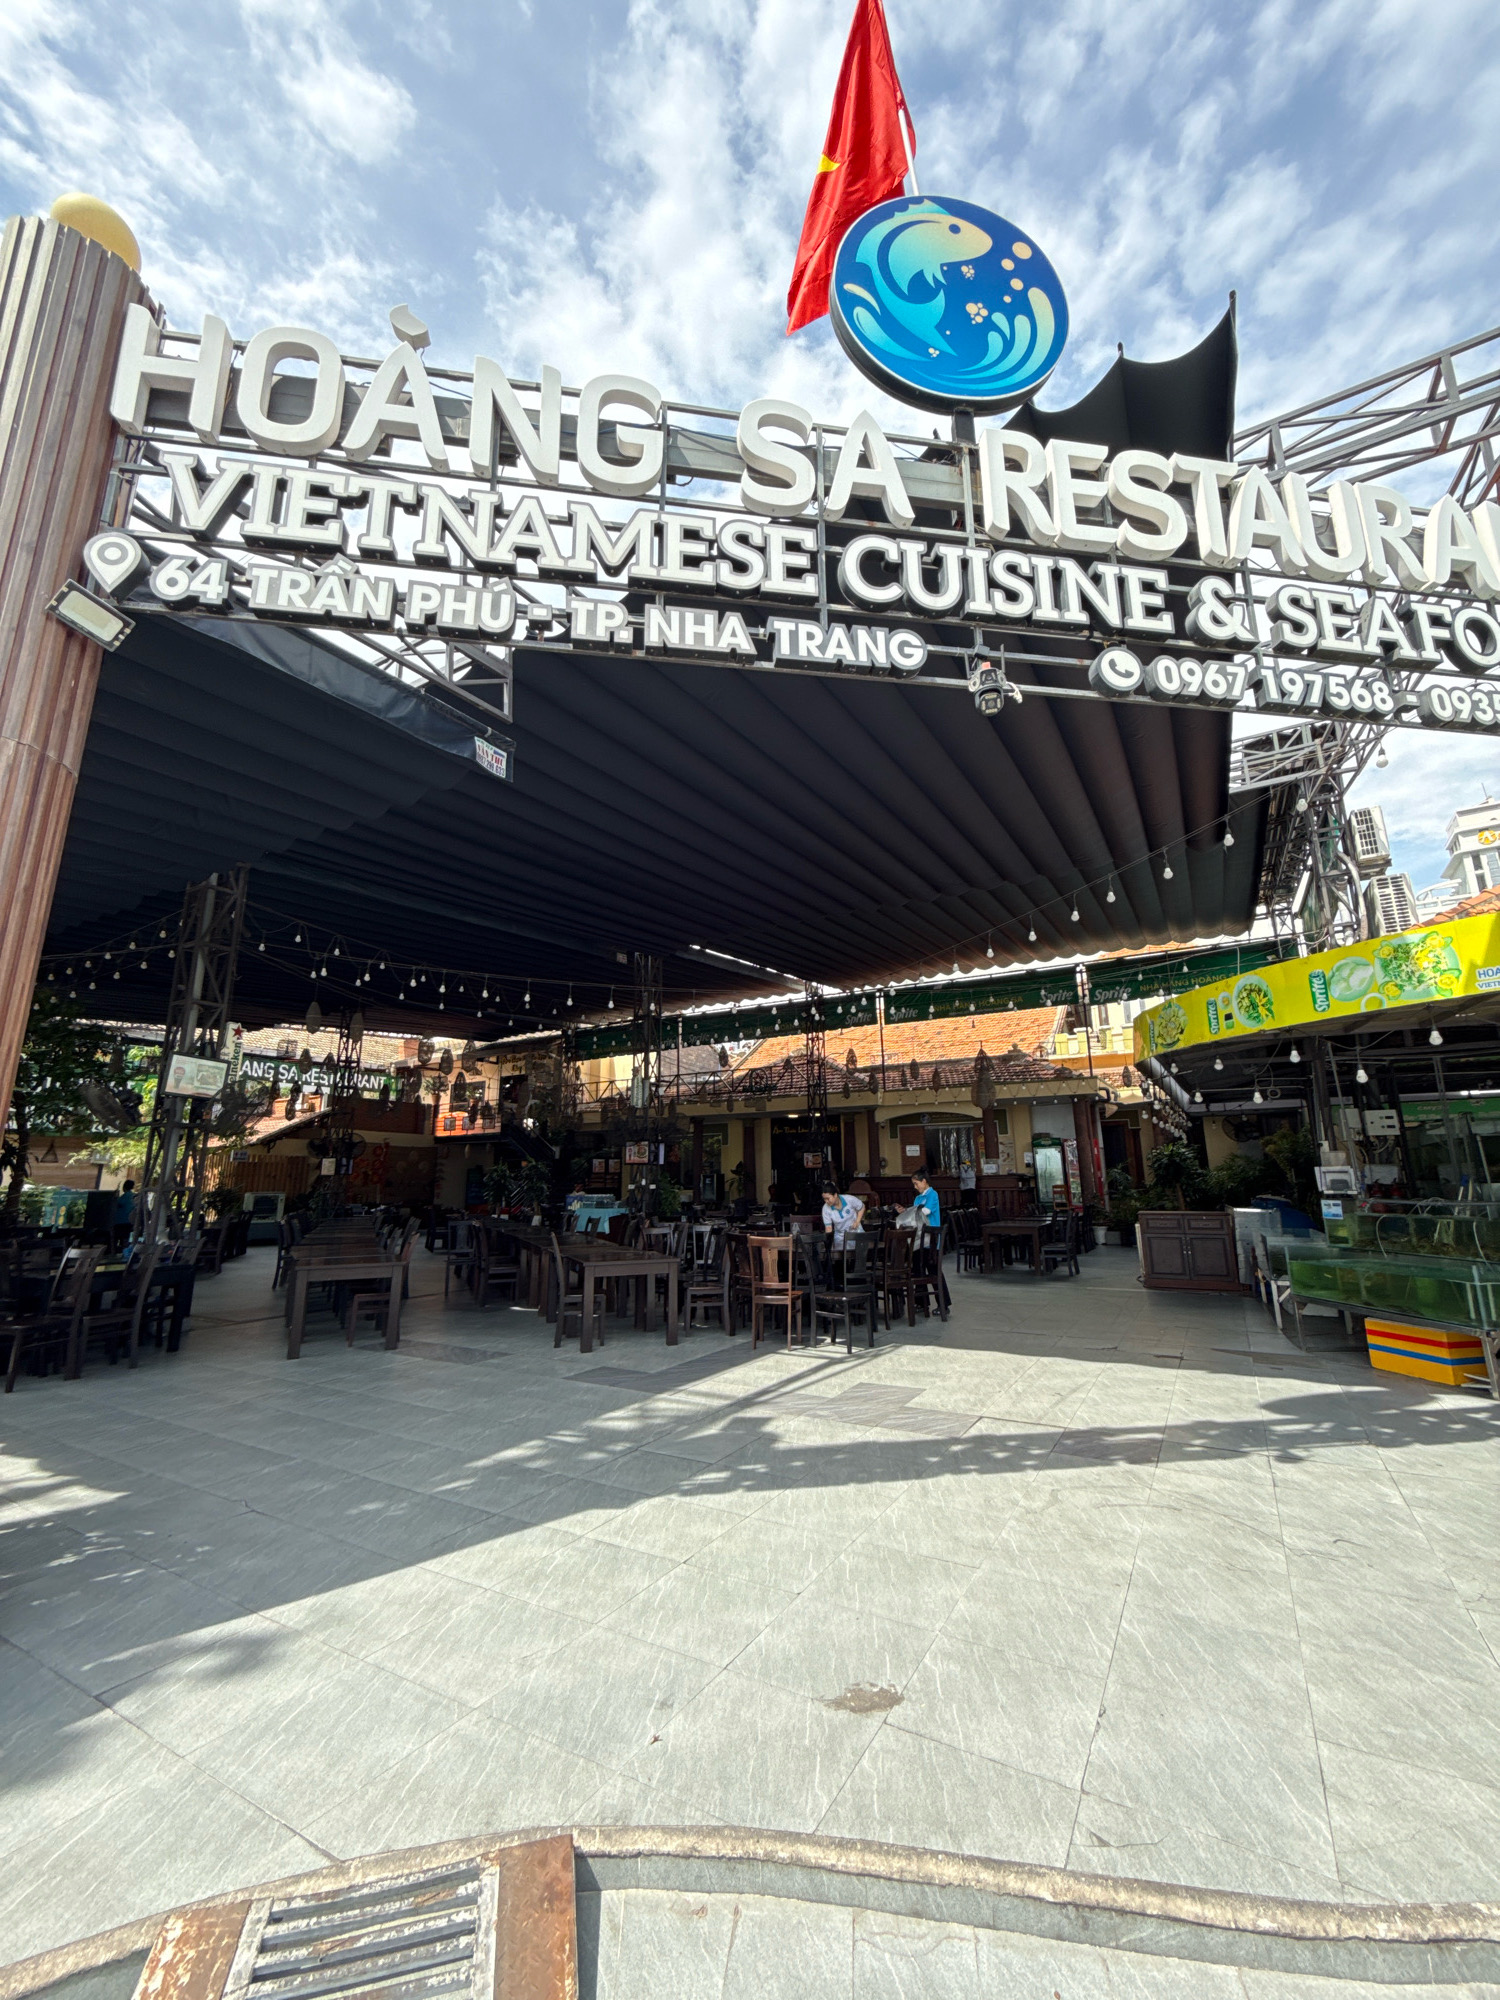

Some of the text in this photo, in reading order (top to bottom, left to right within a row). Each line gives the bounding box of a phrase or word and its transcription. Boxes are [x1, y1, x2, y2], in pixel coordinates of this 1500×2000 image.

[110, 303, 664, 496] HOÀNG
[737, 399, 915, 529] SA
[161, 451, 819, 602] VIETNAMESE
[839, 533, 1176, 638] CUISINE
[1186, 575, 1260, 646] &
[150, 554, 231, 610] 64
[247, 553, 396, 627] TRẦN
[405, 577, 517, 637] PHÚ
[567, 597, 633, 650] TP.
[645, 604, 757, 660] NHA
[767, 616, 927, 674] TRANG
[1150, 655, 1249, 704] 0967
[1258, 666, 1395, 718] 197568
[1040, 989, 1073, 1004] Sprite
[1095, 986, 1131, 1001] Sprite
[845, 1012, 872, 1025] Sprite
[890, 1008, 918, 1021] Sprite
[279, 1064, 298, 1081] SA
